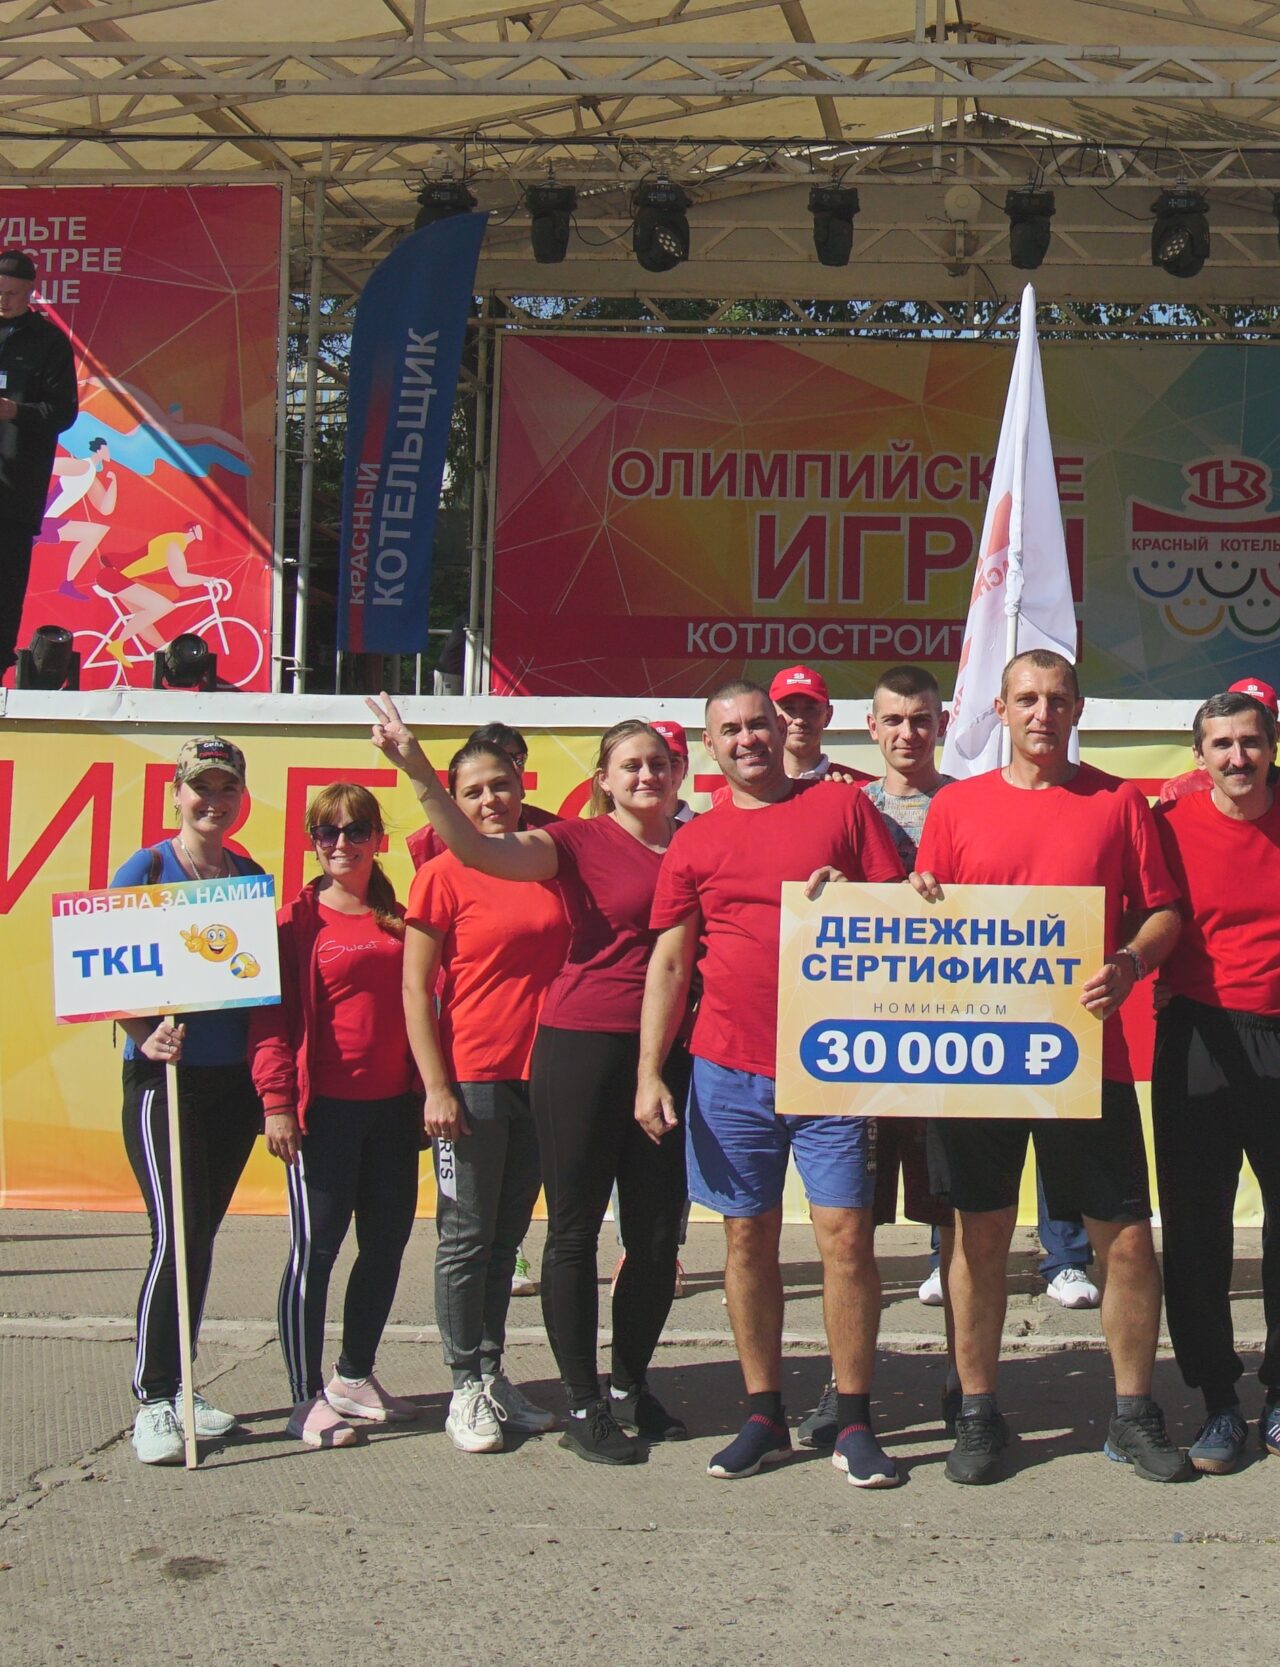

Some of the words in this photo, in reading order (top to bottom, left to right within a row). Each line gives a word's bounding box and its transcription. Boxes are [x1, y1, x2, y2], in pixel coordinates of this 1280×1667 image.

[373, 327, 441, 607] КОТЕЛЬЩИК
[611, 440, 1085, 501] ОЛИМПИЙСКЕ
[349, 461, 382, 606] КРАСНЫЙ
[1131, 535, 1209, 551] КРАСНЫЙ
[755, 514, 1084, 602] ИГР
[59, 892, 155, 917] ПОБЕДА
[160, 888, 190, 908] ЗА
[197, 881, 269, 904] НАМИ!
[815, 913, 1066, 949] ДЕНЕЖНЫЙ
[72, 942, 163, 978] ТКЦ
[317, 940, 380, 963] Sweet
[801, 954, 1081, 985] СЕРТИФИКАТ
[873, 1002, 1007, 1016] НОМИНАЛОМ
[816, 1029, 887, 1074] 30
[897, 1031, 1005, 1076] 000
